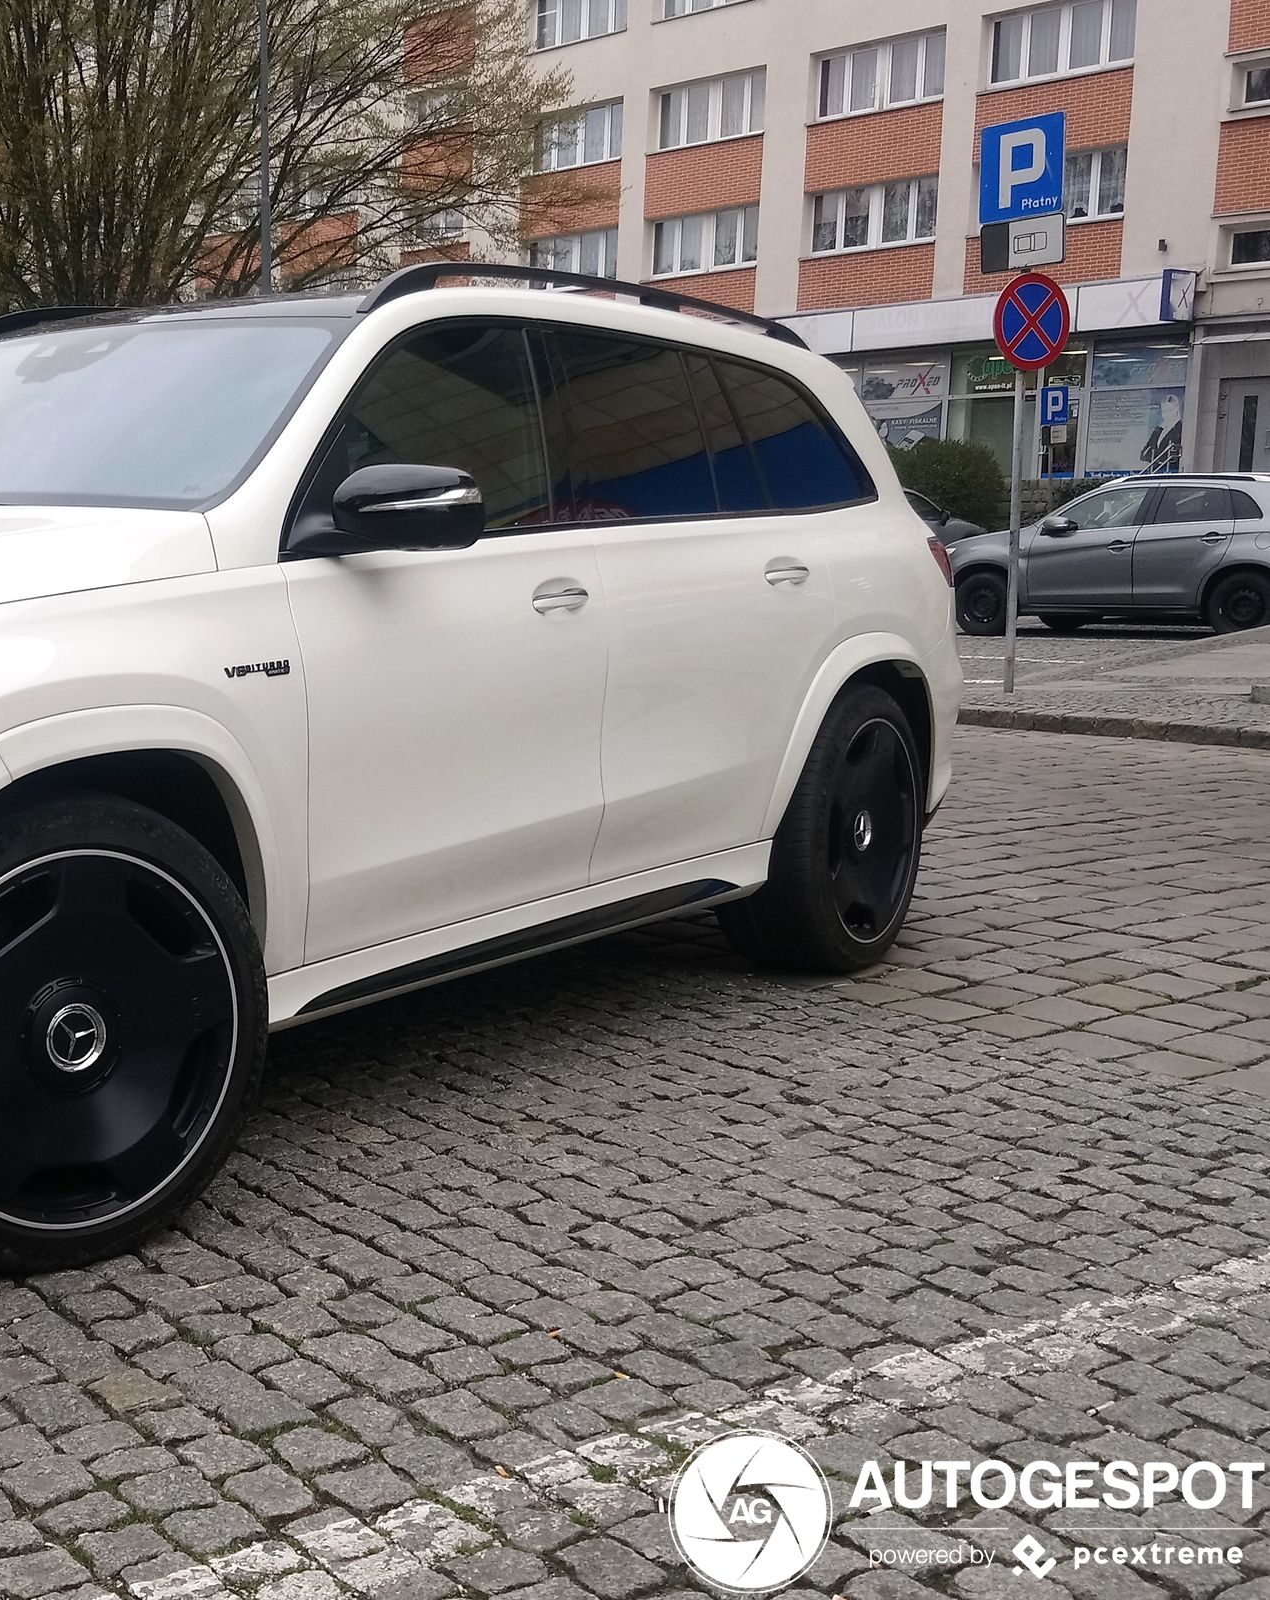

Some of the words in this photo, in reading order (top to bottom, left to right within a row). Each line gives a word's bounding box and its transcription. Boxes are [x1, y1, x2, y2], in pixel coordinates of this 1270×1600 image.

[998, 127, 1046, 209] P
[1021, 196, 1058, 211] Płatny
[1047, 391, 1063, 420] P
